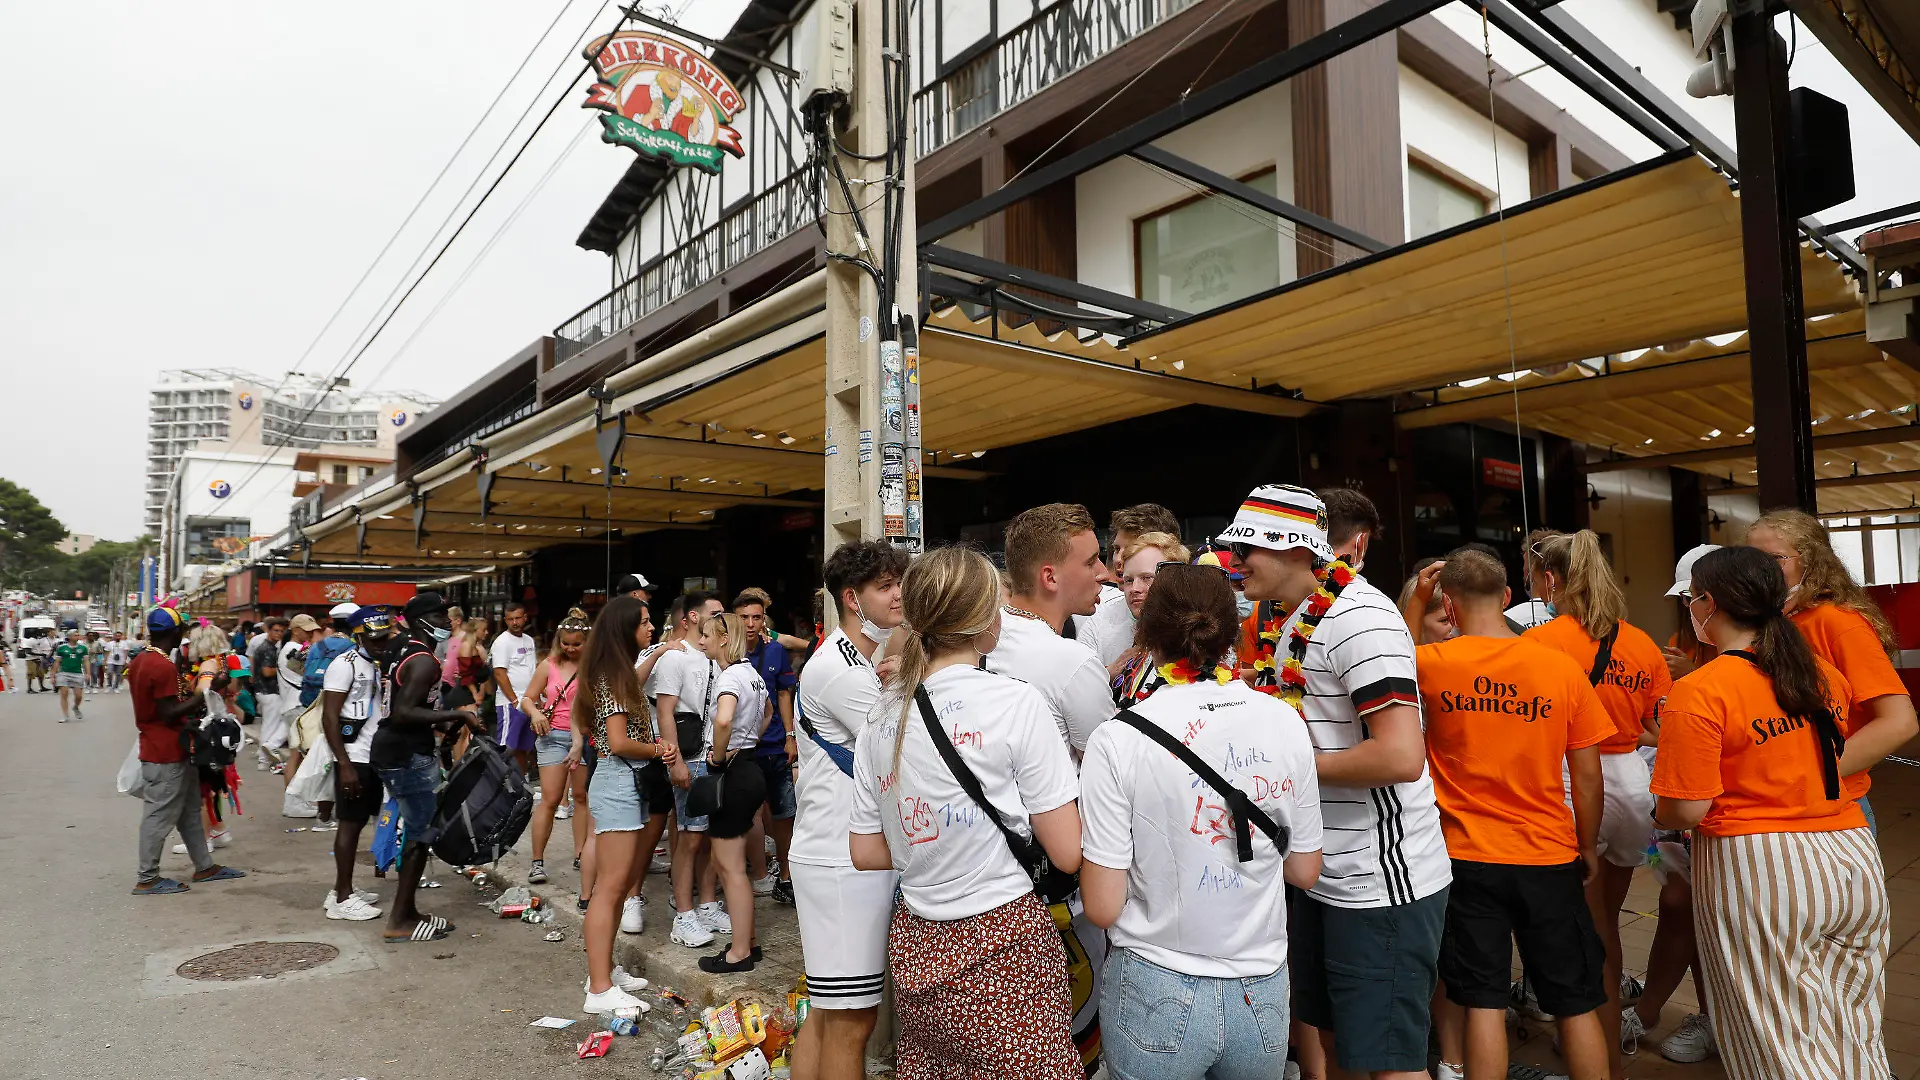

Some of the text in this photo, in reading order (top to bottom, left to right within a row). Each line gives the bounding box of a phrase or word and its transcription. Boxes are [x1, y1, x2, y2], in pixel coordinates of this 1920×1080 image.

[597, 41, 739, 111] BIERKÖNIG
[1607, 659, 1626, 673] ns
[1473, 675, 1518, 698] Ons
[1601, 670, 1651, 694] mcafé
[351, 699, 365, 717] 11
[938, 699, 965, 721] ritz
[1440, 690, 1552, 723] Stamcafé
